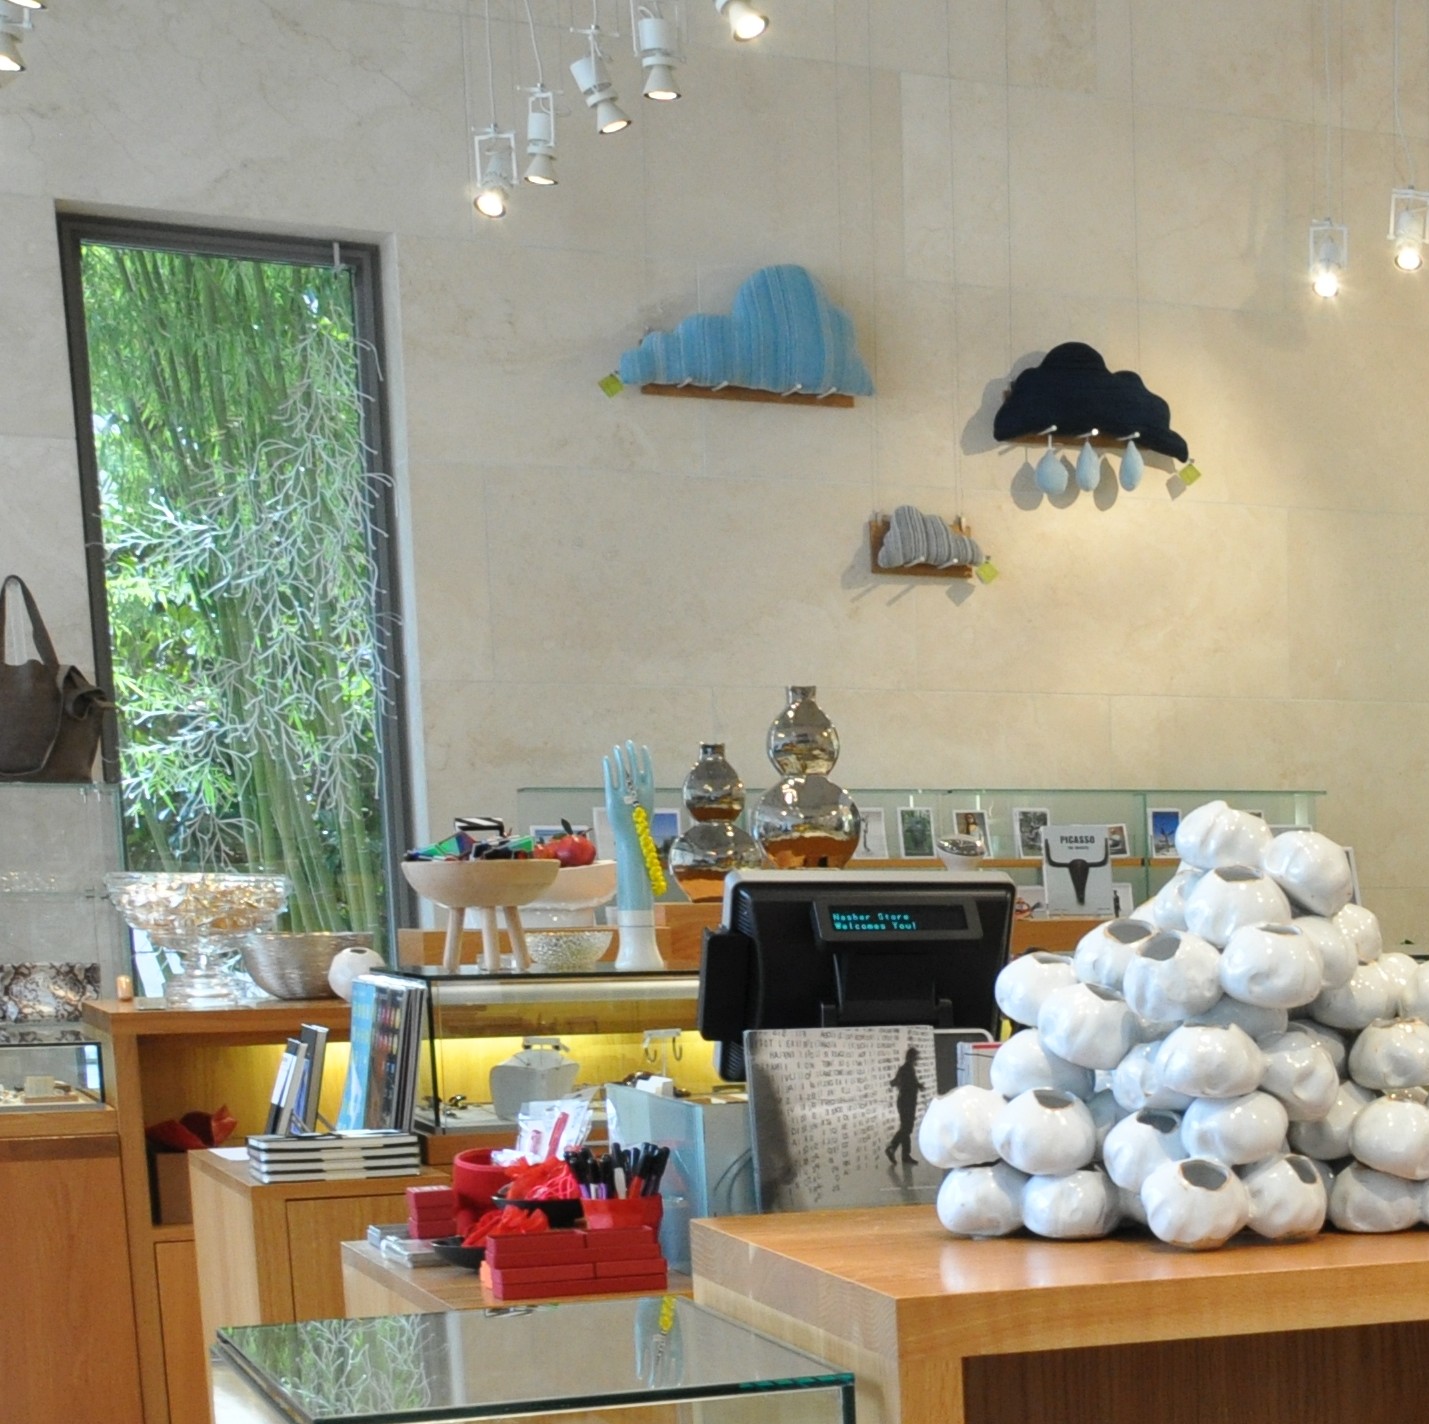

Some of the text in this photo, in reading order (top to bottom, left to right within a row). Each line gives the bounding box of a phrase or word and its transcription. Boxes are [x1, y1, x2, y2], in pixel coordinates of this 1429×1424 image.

[1060, 835, 1095, 844] PICASSO
[832, 912, 909, 921] Nasher Store
[834, 921, 916, 930] Welcomes You!
